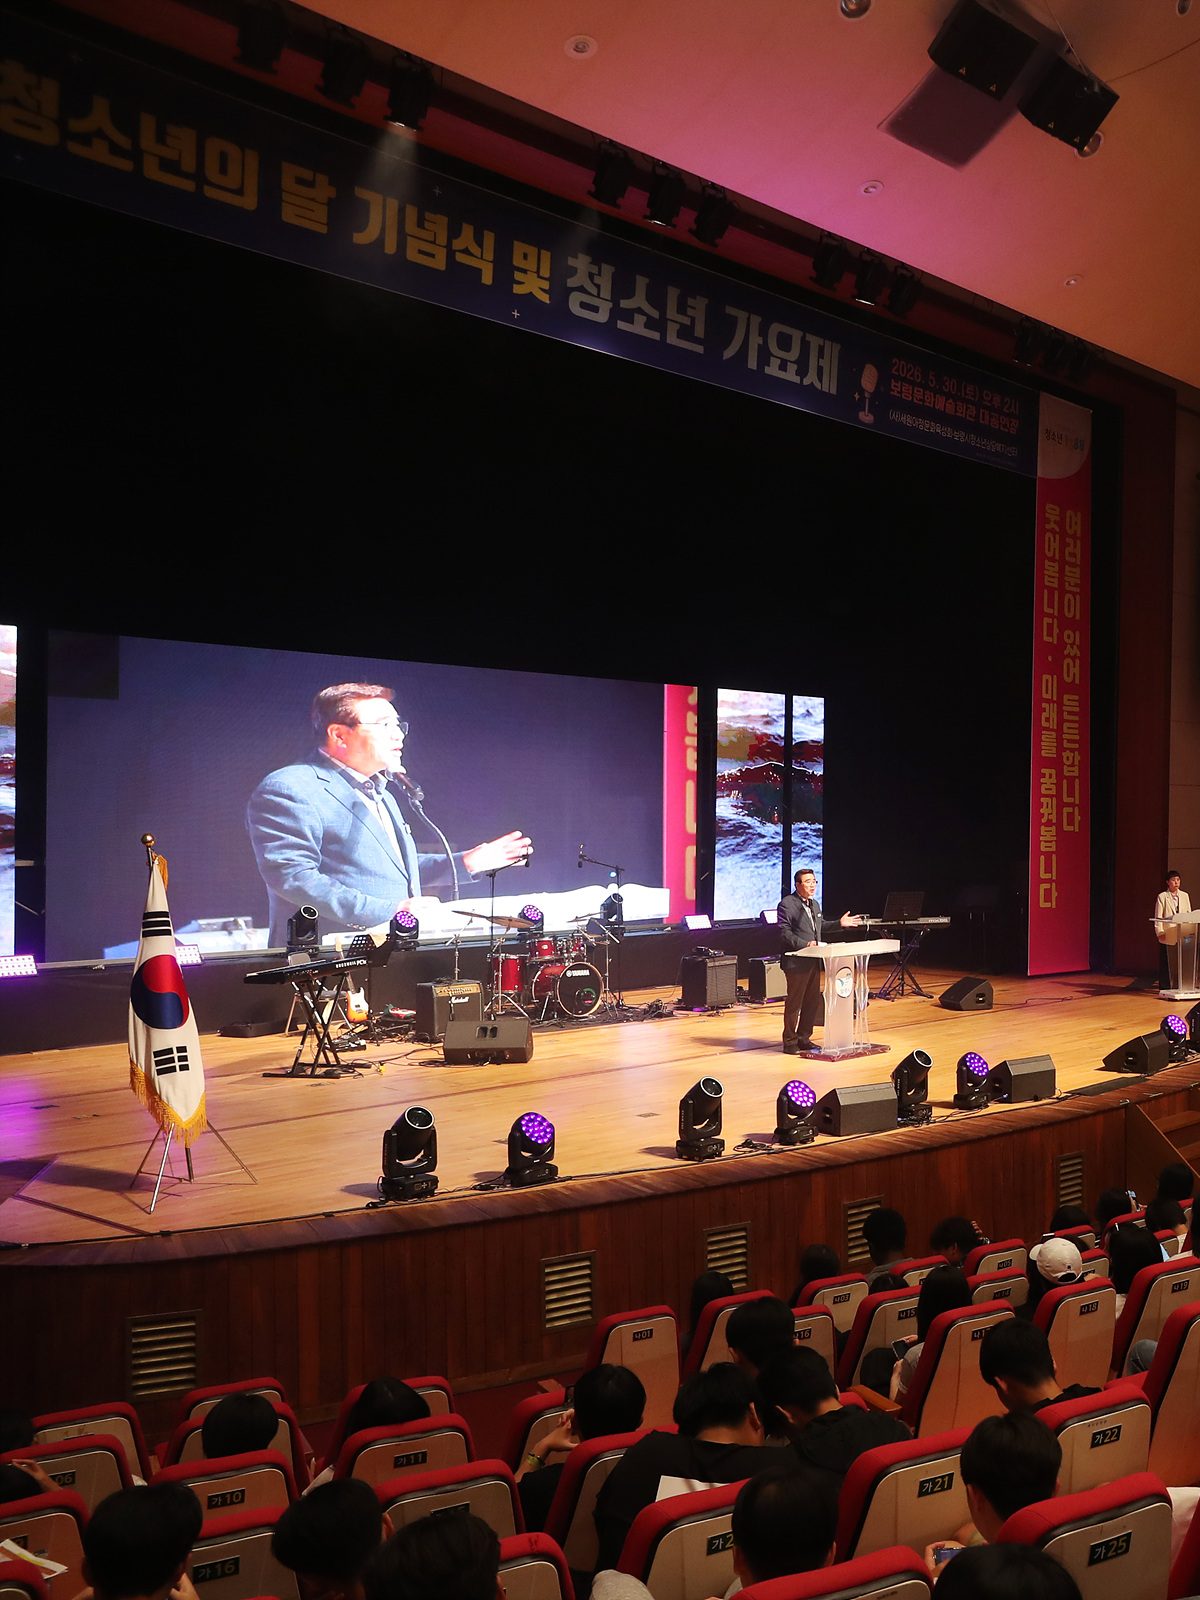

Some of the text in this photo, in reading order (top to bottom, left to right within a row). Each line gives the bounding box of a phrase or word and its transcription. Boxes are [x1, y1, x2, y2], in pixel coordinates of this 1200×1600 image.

[0, 58, 841, 395] 청소년의 달 기념식 및 청소년 가요제
[891, 358, 925, 383] 2026.
[982, 390, 1001, 409] 오후
[1004, 397, 1020, 415] 2시
[979, 408, 1020, 435] 대공연장
[1062, 509, 1082, 832] 여러분이 있어 든든합니다
[1041, 674, 1058, 758] 미래를
[1039, 768, 1058, 908] 꿈꿔봅니다
[1095, 1428, 1118, 1444] 가22
[397, 1453, 423, 1466] 가11
[923, 1477, 950, 1493] 가21
[211, 1491, 242, 1506] 가10
[1095, 1537, 1127, 1559] 가25
[198, 1560, 235, 1579] 가16
